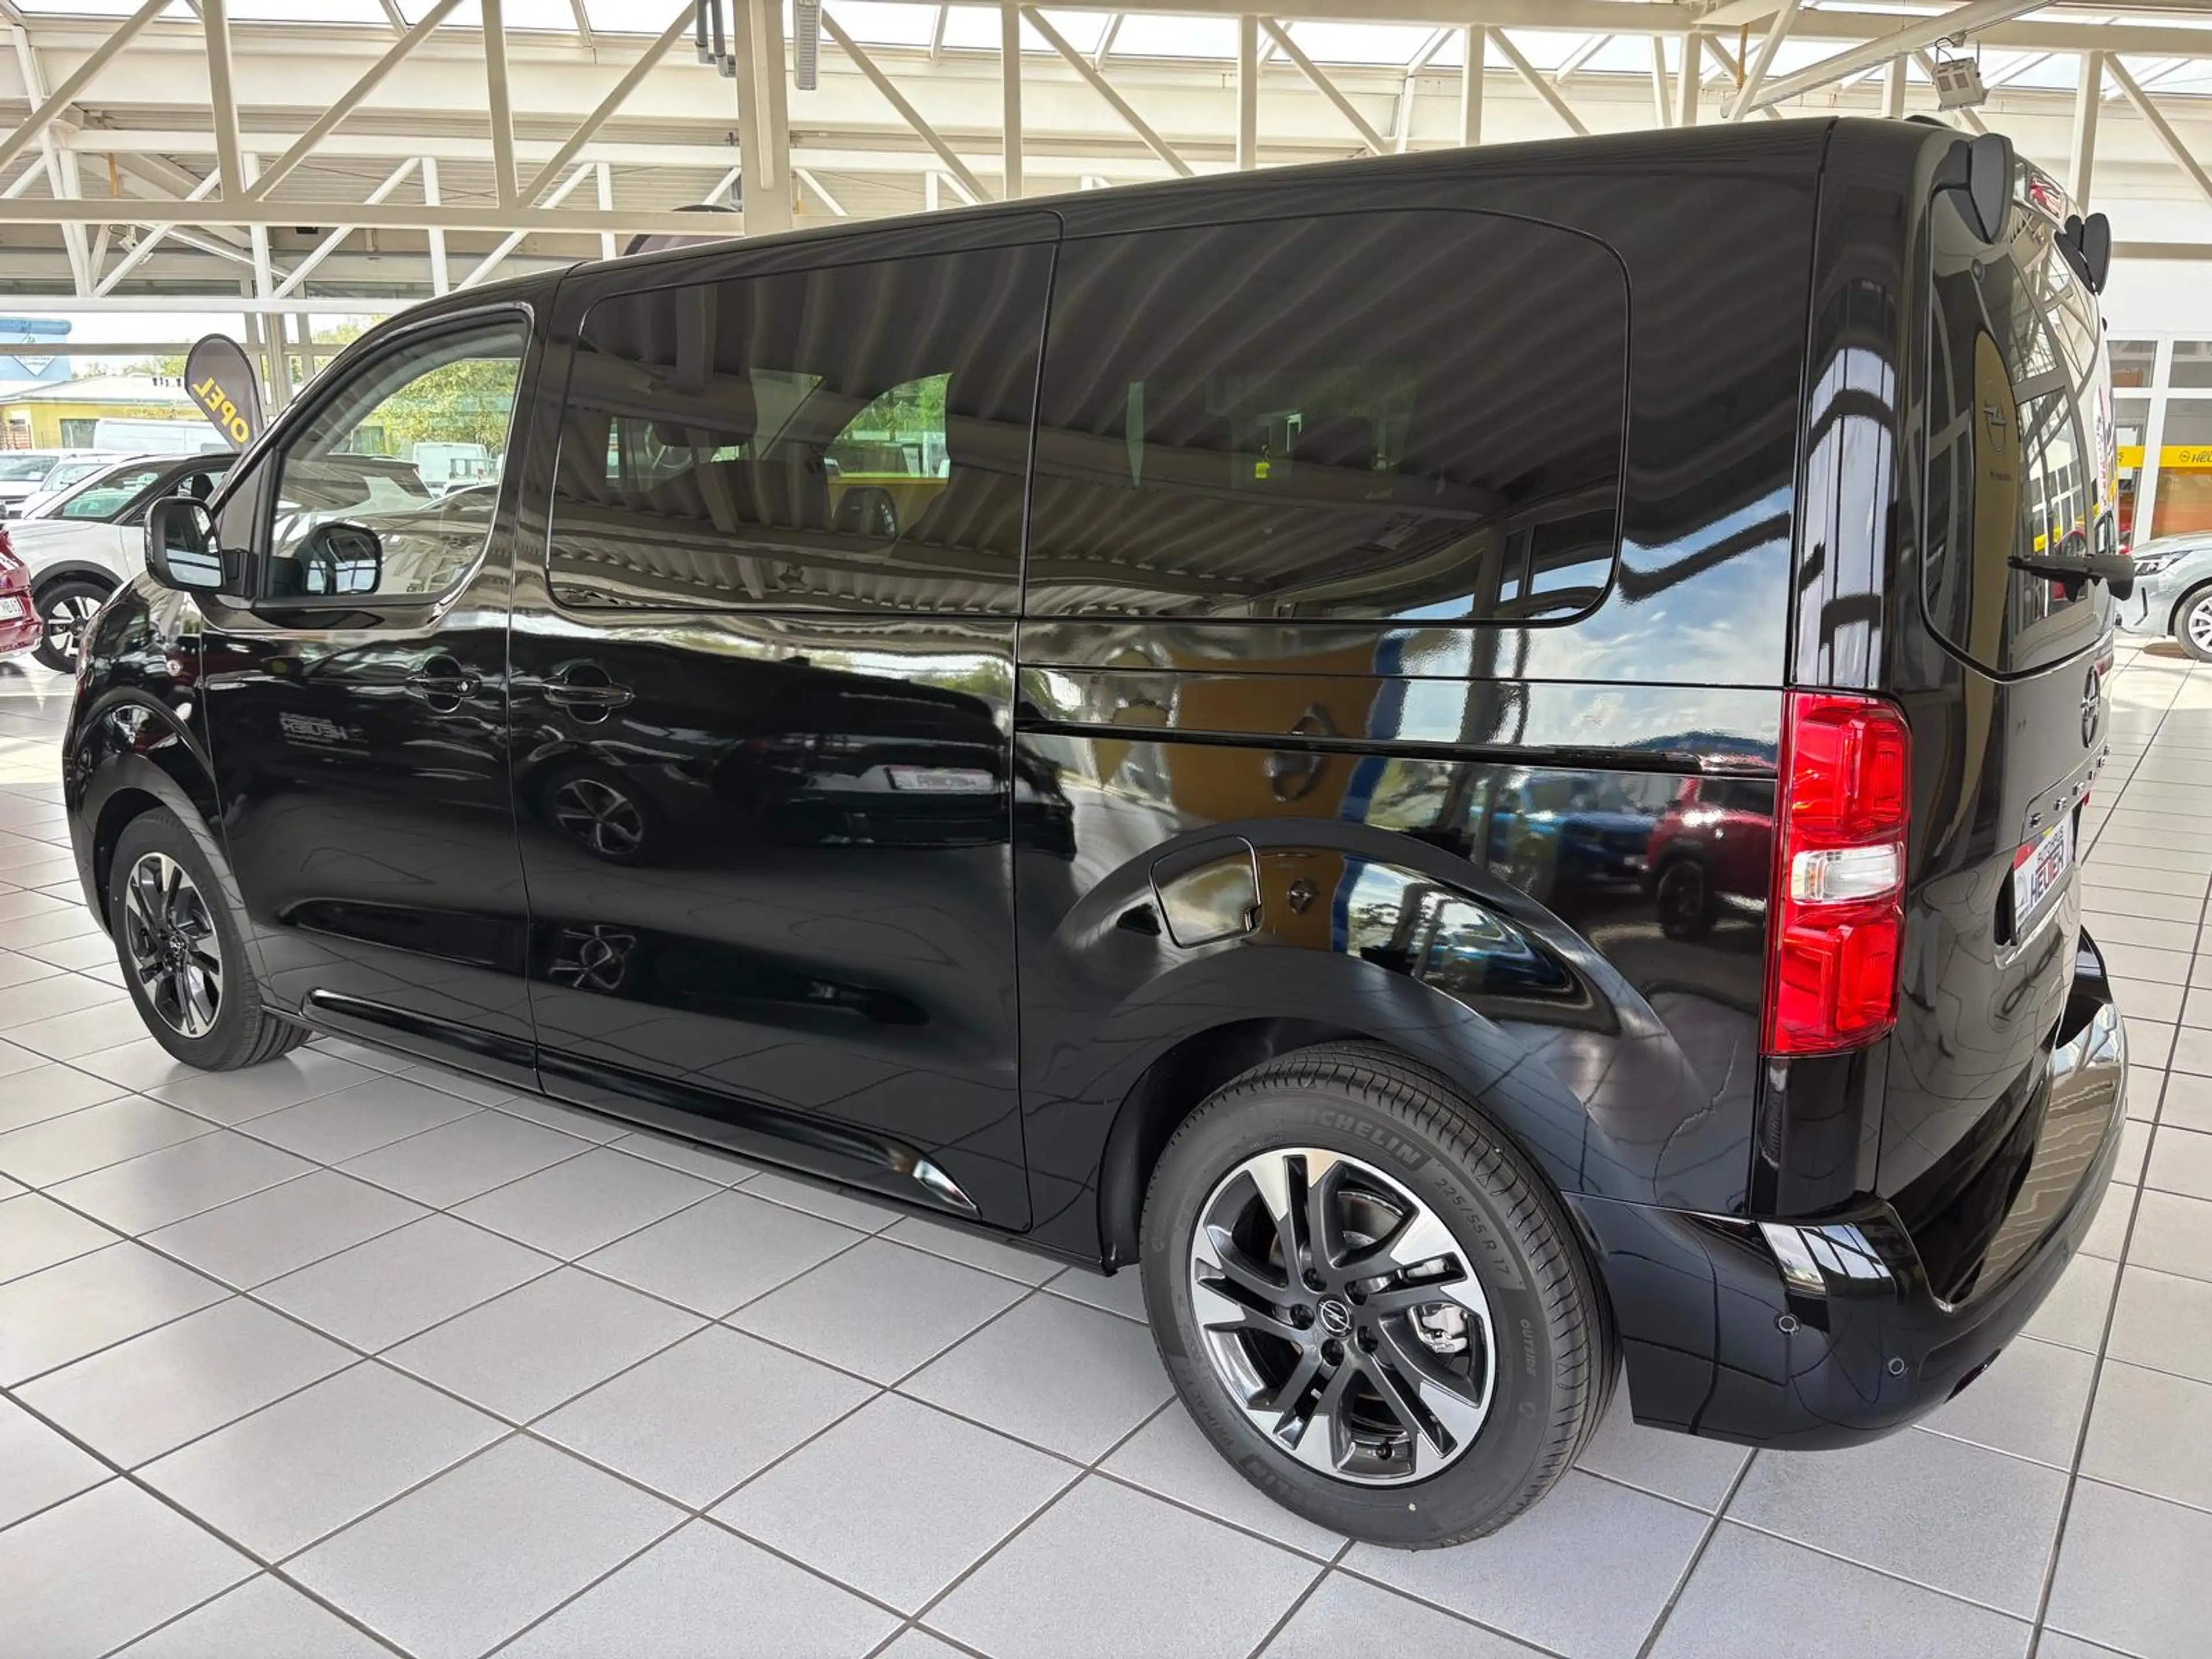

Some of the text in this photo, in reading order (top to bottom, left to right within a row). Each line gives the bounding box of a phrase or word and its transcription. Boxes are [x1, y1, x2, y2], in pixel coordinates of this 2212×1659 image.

[1434, 1178, 1511, 1275] 225/55 R 17
